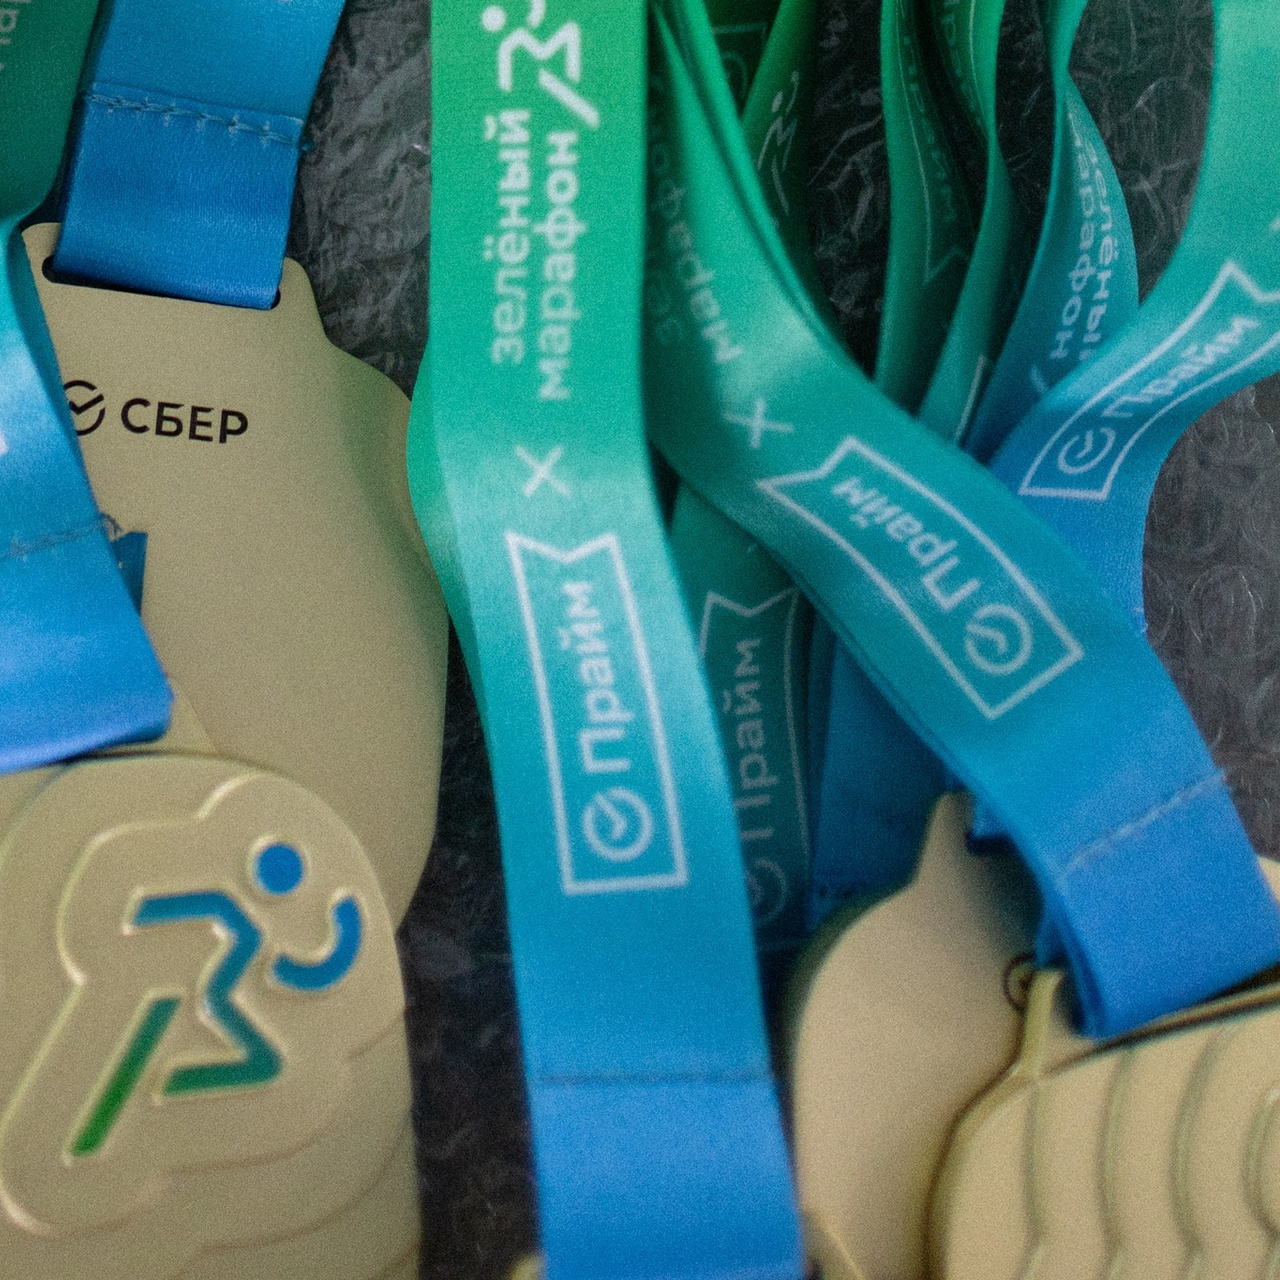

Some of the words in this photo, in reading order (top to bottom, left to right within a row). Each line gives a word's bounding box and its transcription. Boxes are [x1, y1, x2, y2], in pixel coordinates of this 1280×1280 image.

[482, 109, 533, 366] зелёный
[533, 130, 590, 404] марафон
[119, 396, 250, 445] СБЕР
[831, 474, 982, 612] Прайм
[560, 576, 633, 776] Прайм
